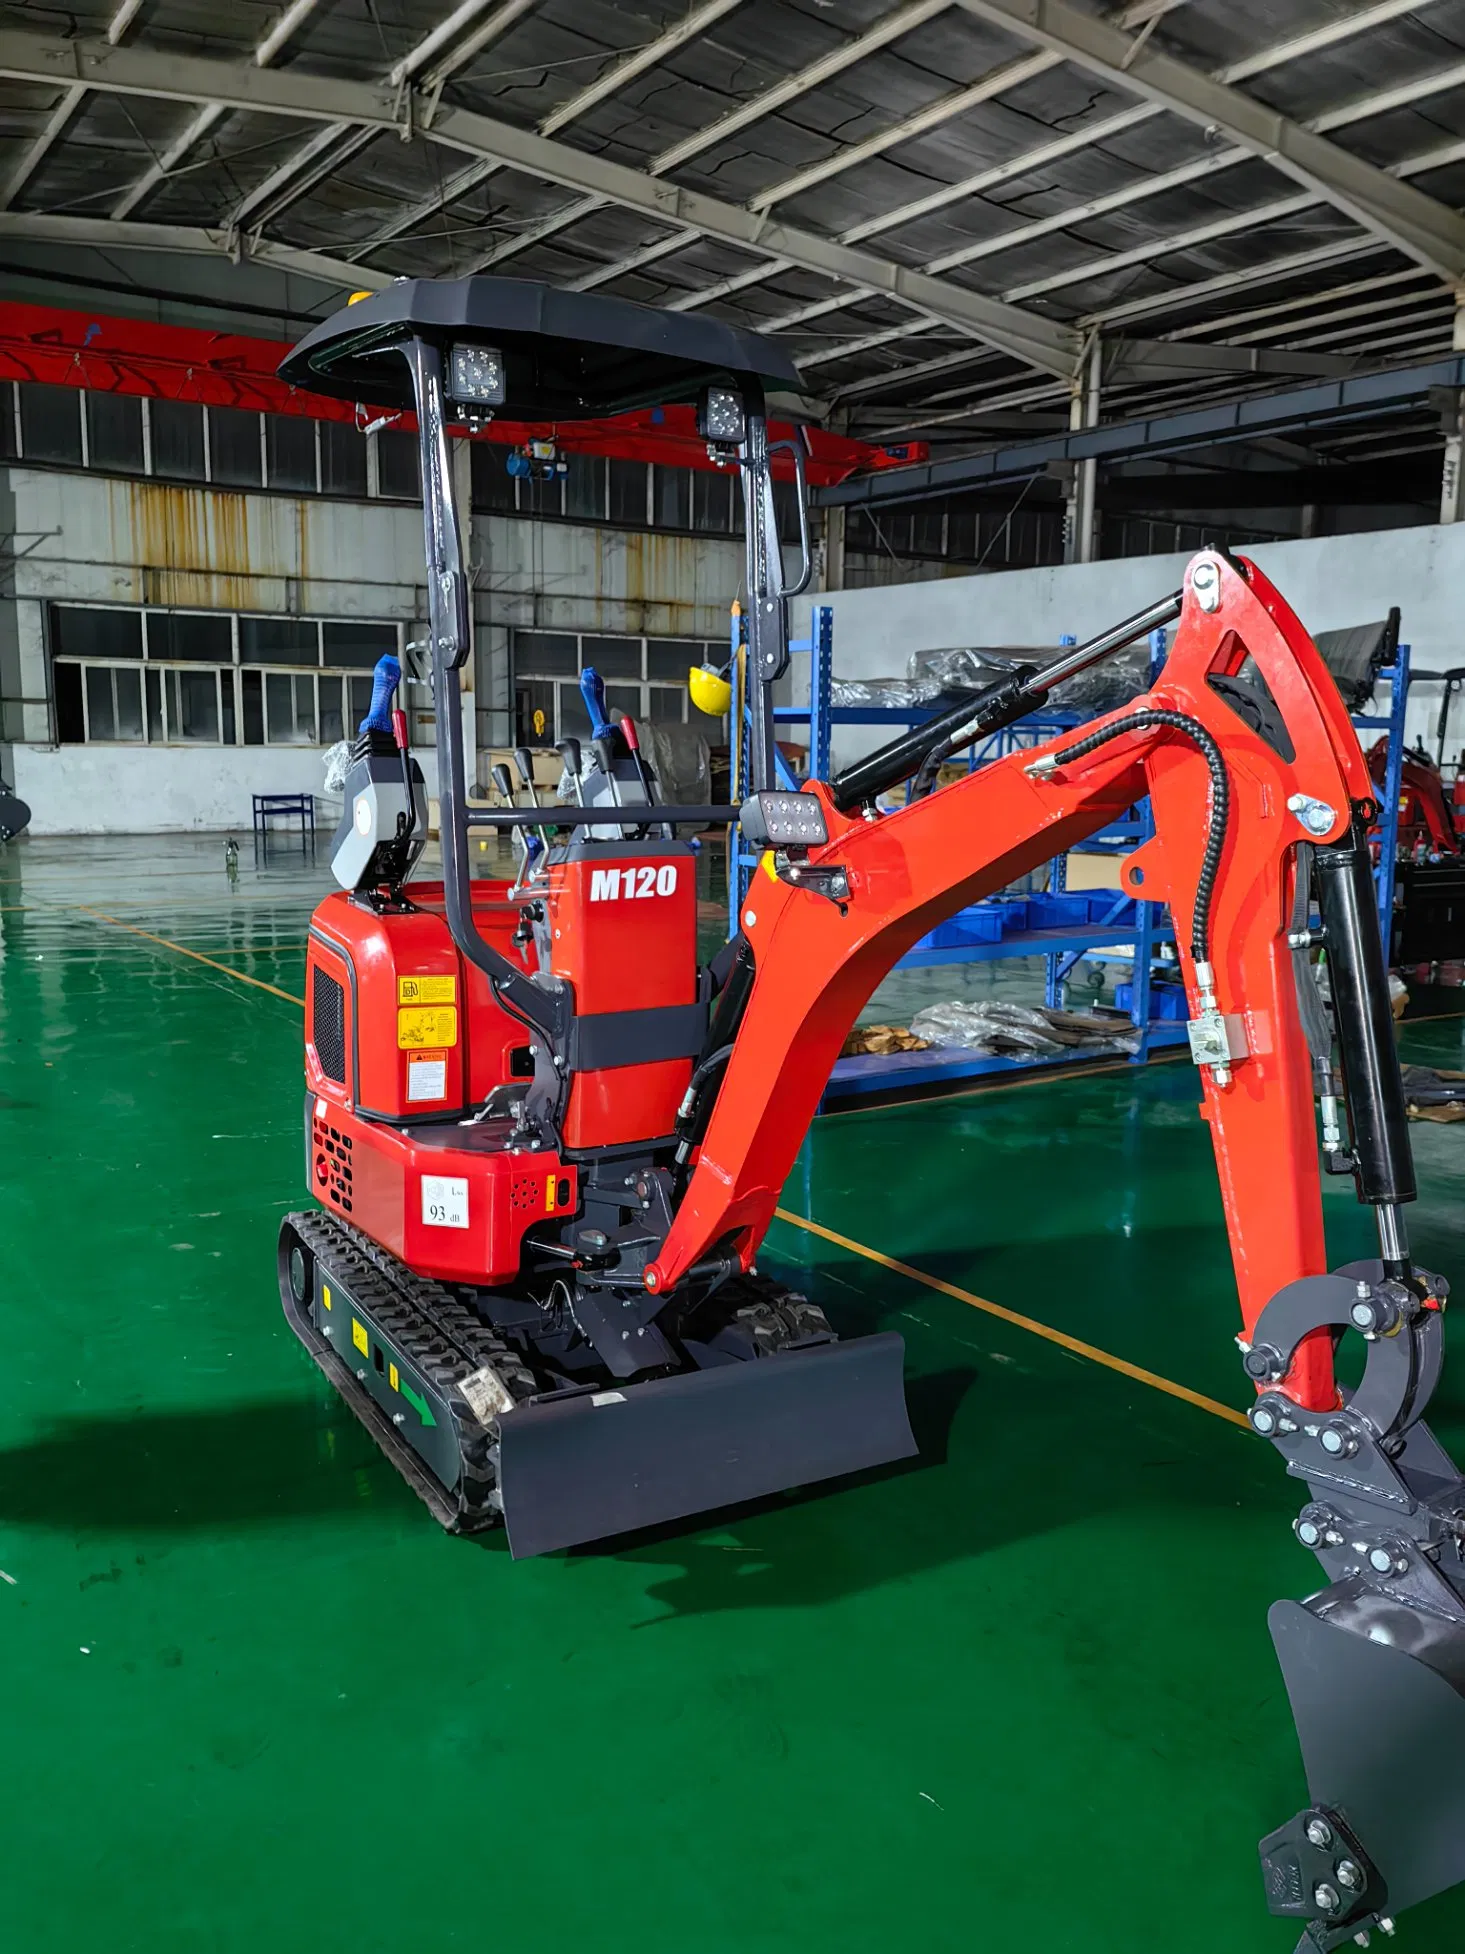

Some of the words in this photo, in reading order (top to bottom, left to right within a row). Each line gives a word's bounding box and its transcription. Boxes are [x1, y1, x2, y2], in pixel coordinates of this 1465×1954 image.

[590, 864, 677, 902] M120
[429, 1204, 446, 1221] 93
[449, 1214, 460, 1222] dB
